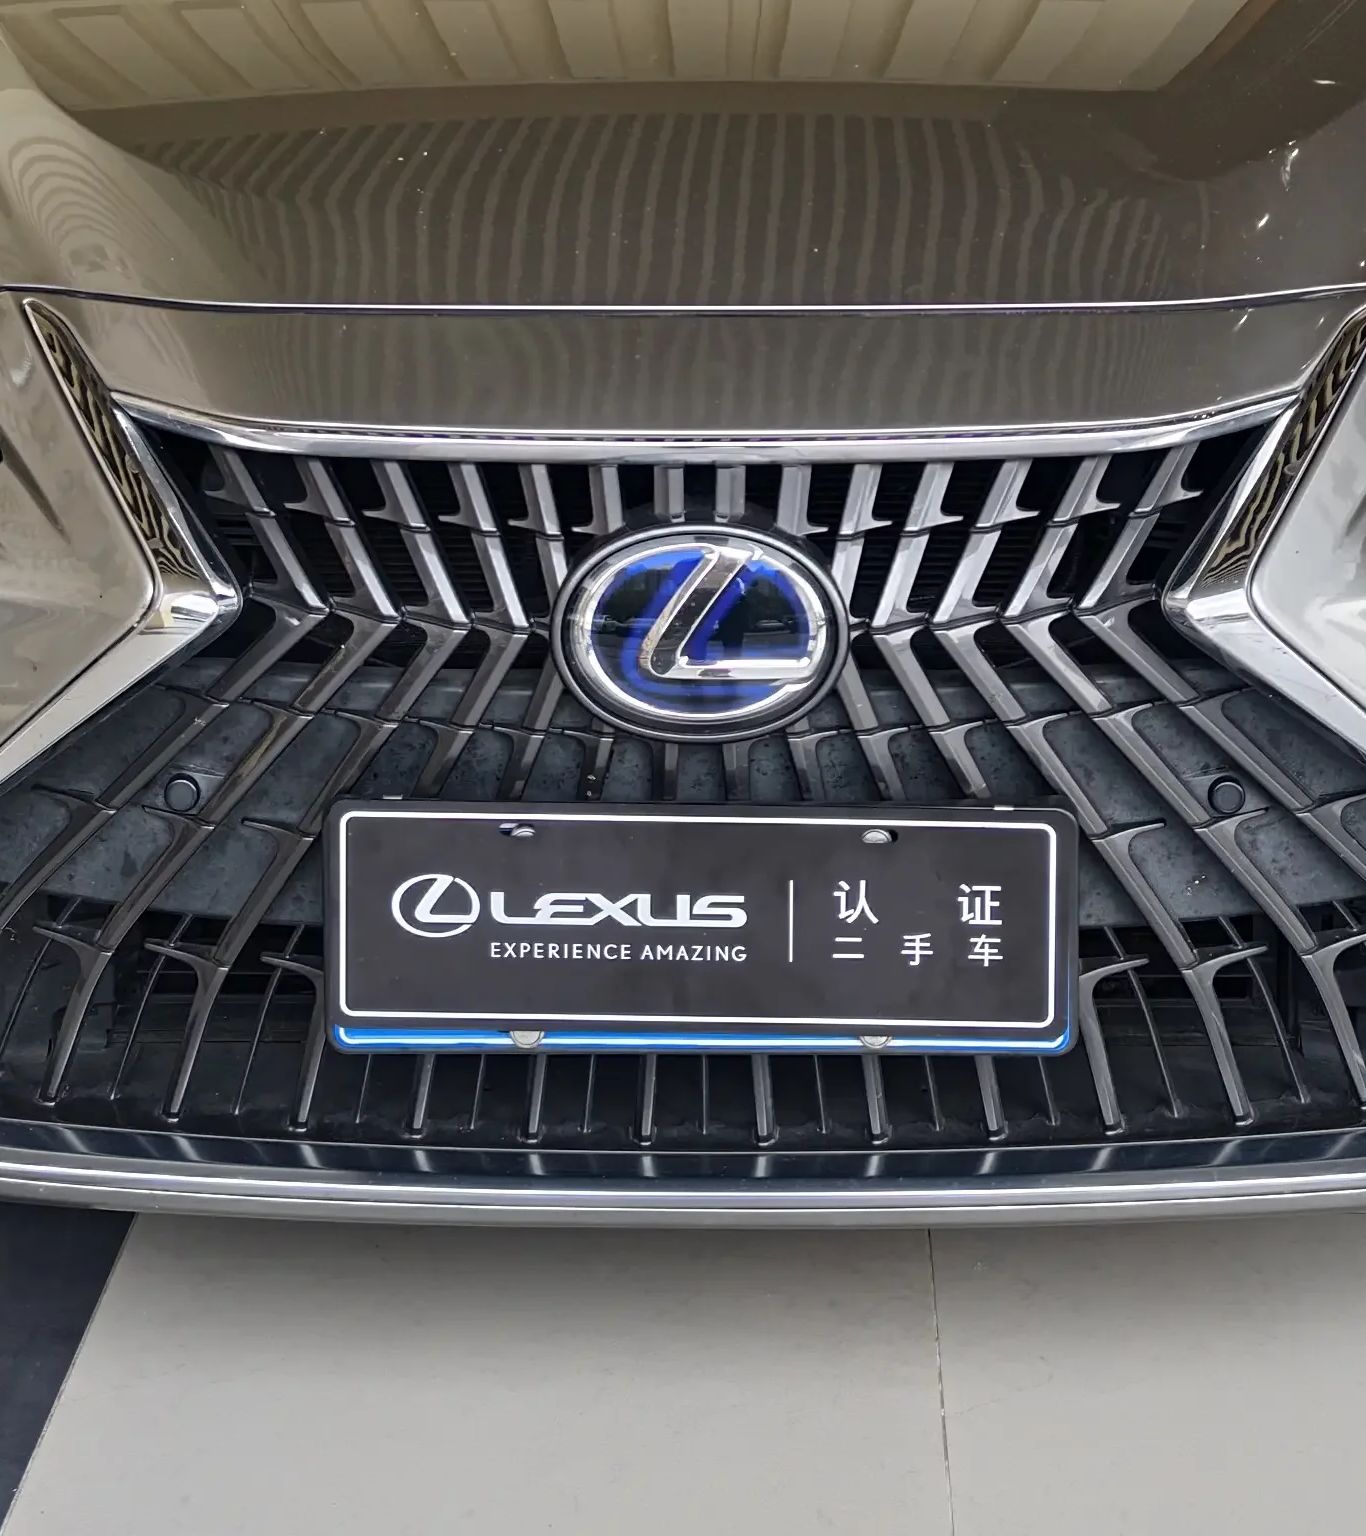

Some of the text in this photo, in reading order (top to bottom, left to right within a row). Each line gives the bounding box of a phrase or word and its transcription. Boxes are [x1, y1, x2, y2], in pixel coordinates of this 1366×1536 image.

[490, 890, 747, 928] LEXUS
[833, 880, 1004, 927] 认证
[490, 941, 748, 963] EXPERIENCE AMAZING
[832, 933, 1005, 967] 二手车
